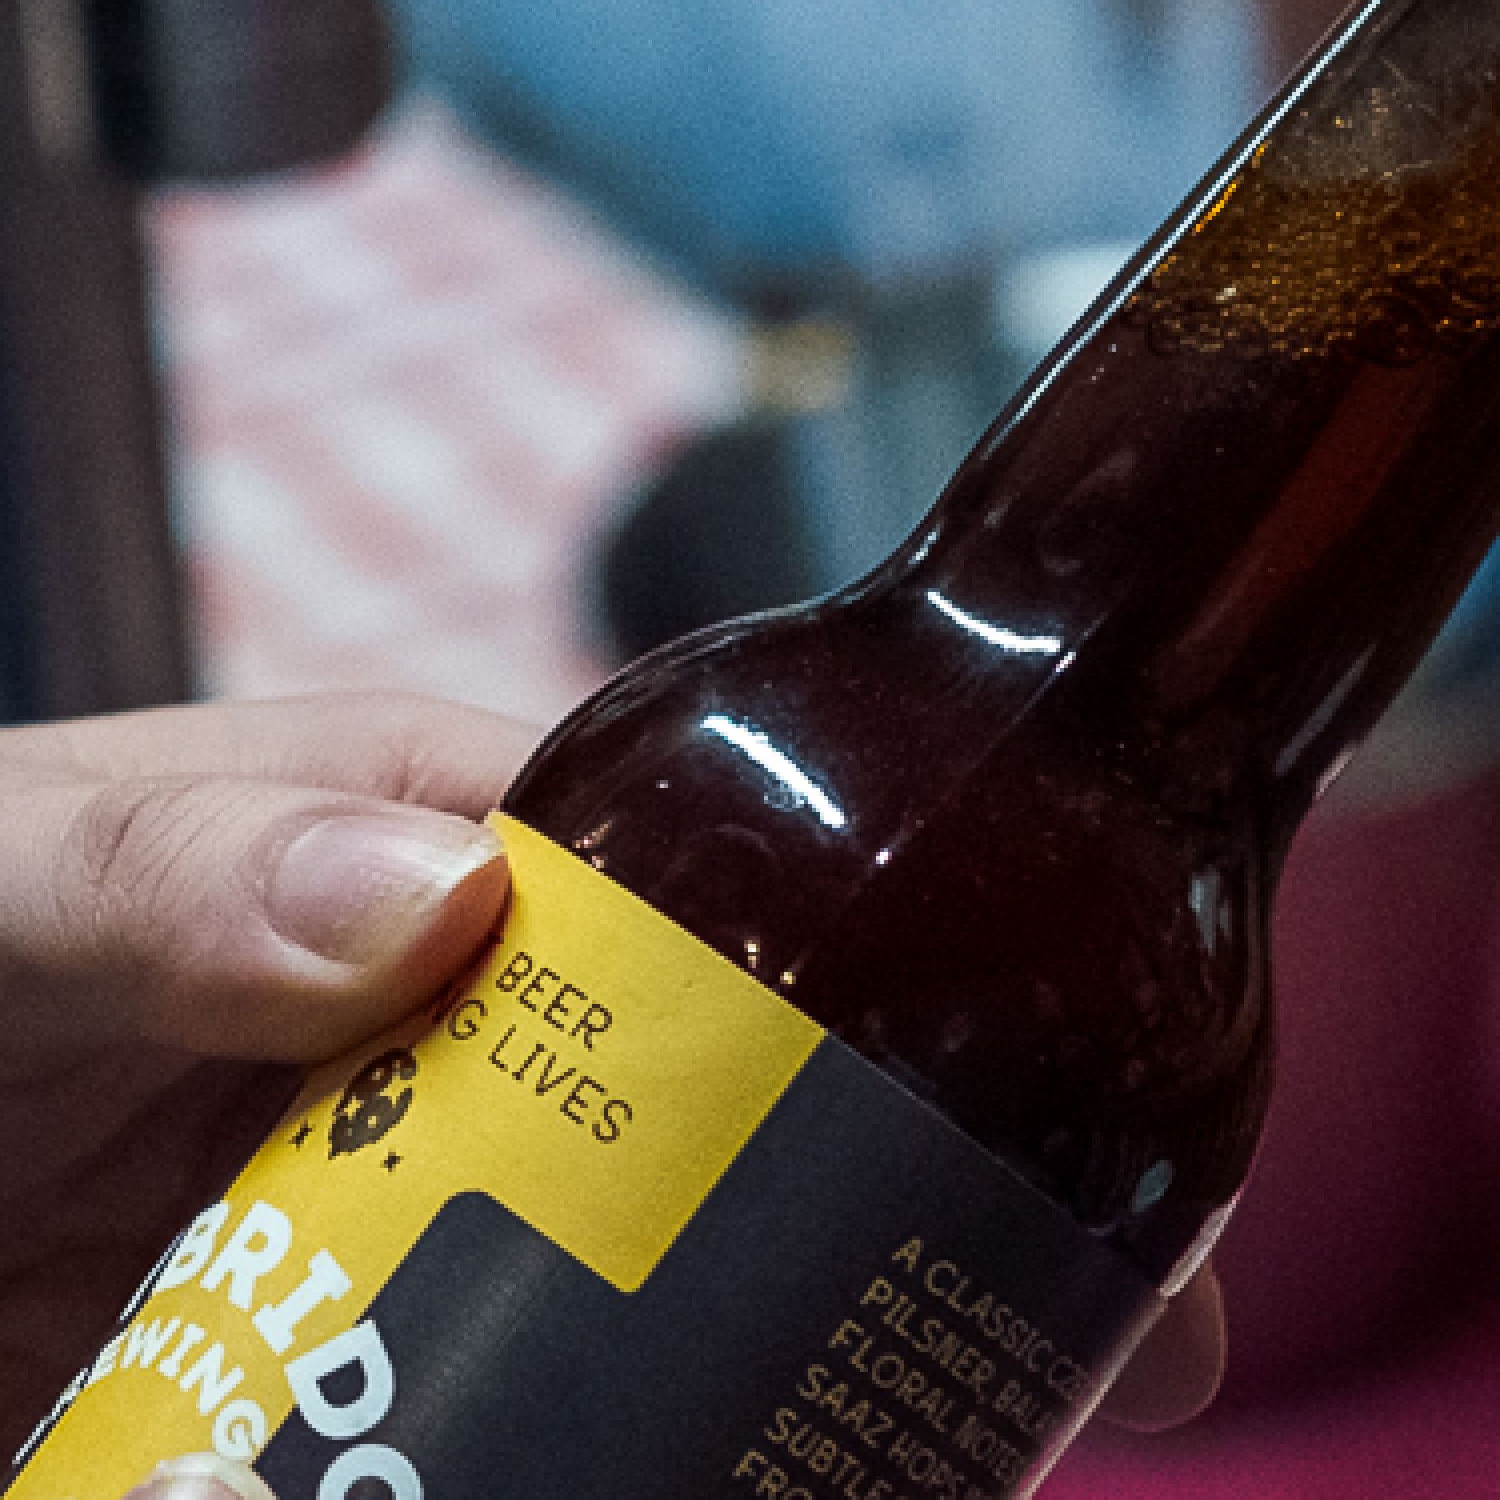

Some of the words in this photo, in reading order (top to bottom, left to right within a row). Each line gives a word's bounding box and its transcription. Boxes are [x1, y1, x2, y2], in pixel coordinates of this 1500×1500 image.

[495, 950, 613, 1051] BEER
[488, 1025, 633, 1144] LIVES
[55, 1316, 267, 1461] EWING
[858, 1275, 996, 1404] PILSNER,
[991, 1379, 1053, 1436] BALA
[890, 1236, 924, 1274] A
[923, 1258, 1054, 1373] CLASSIC
[1044, 1354, 1099, 1408] CZE
[796, 1363, 895, 1449] SAAZ
[827, 1318, 955, 1433] FLORAL
[951, 1413, 1020, 1480] NOTES
